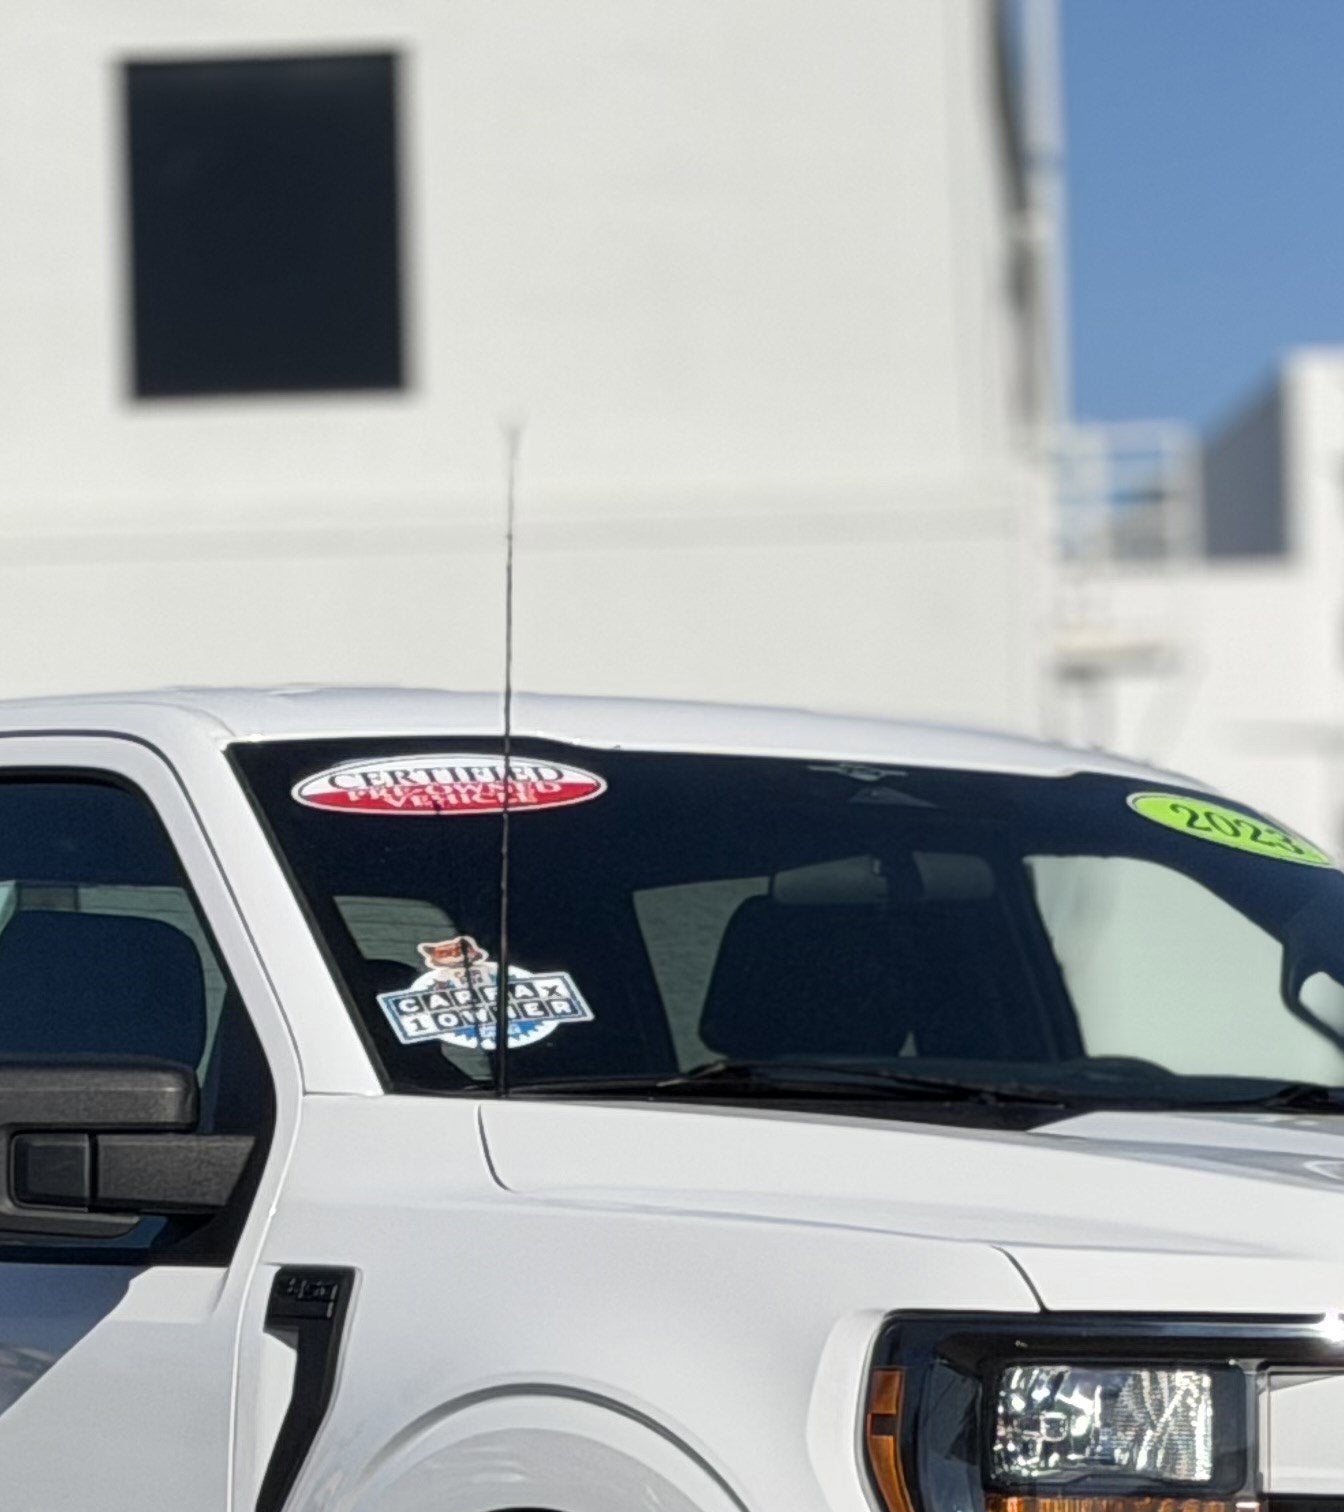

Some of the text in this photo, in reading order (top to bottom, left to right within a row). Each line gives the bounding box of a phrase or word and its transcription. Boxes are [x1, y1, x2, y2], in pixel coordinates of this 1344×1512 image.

[328, 765, 564, 790] CERTIFIED
[1169, 803, 1305, 855] 2023
[397, 982, 563, 1015] CARFAX
